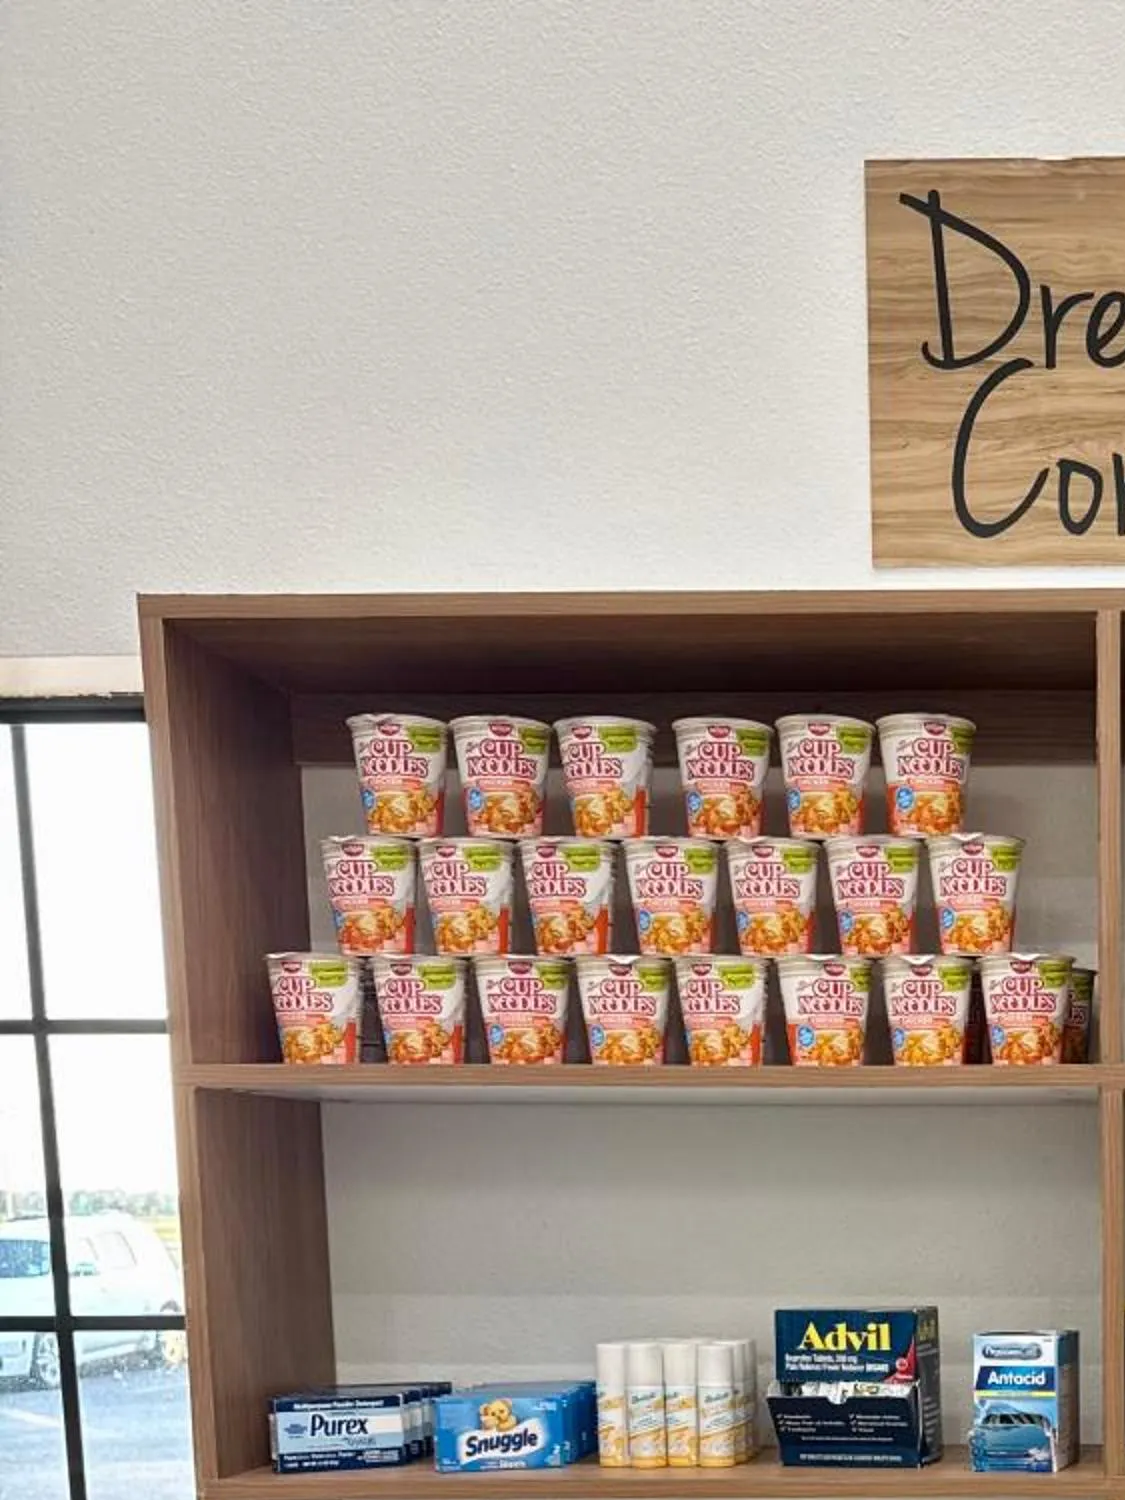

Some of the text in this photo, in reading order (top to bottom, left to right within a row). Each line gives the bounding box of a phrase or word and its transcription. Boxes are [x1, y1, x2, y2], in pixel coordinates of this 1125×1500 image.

[370, 740, 414, 759] CUP
[480, 739, 524, 758] CUP
[568, 742, 607, 760] CUP
[700, 743, 741, 760] CUP
[800, 740, 842, 759] CUP
[913, 740, 956, 759] CUP
[338, 861, 379, 879] CUP
[432, 861, 469, 879] CUP
[533, 861, 570, 880] CUP
[648, 862, 690, 880] CUP
[744, 862, 784, 880] CUP
[849, 862, 890, 880] CUP
[952, 858, 994, 877] CUP
[278, 978, 316, 996] CUP
[385, 978, 427, 997] CUP
[501, 978, 543, 997] CUP
[601, 978, 644, 997] CUP
[686, 979, 725, 998] CUP
[812, 979, 855, 997] CUP
[901, 979, 943, 998] CUP
[1001, 976, 1044, 996] CUP
[797, 1321, 891, 1351] Advil
[987, 1369, 1046, 1385] Antacid
[310, 1413, 369, 1437] Purex
[465, 1428, 538, 1457] Snuggle
